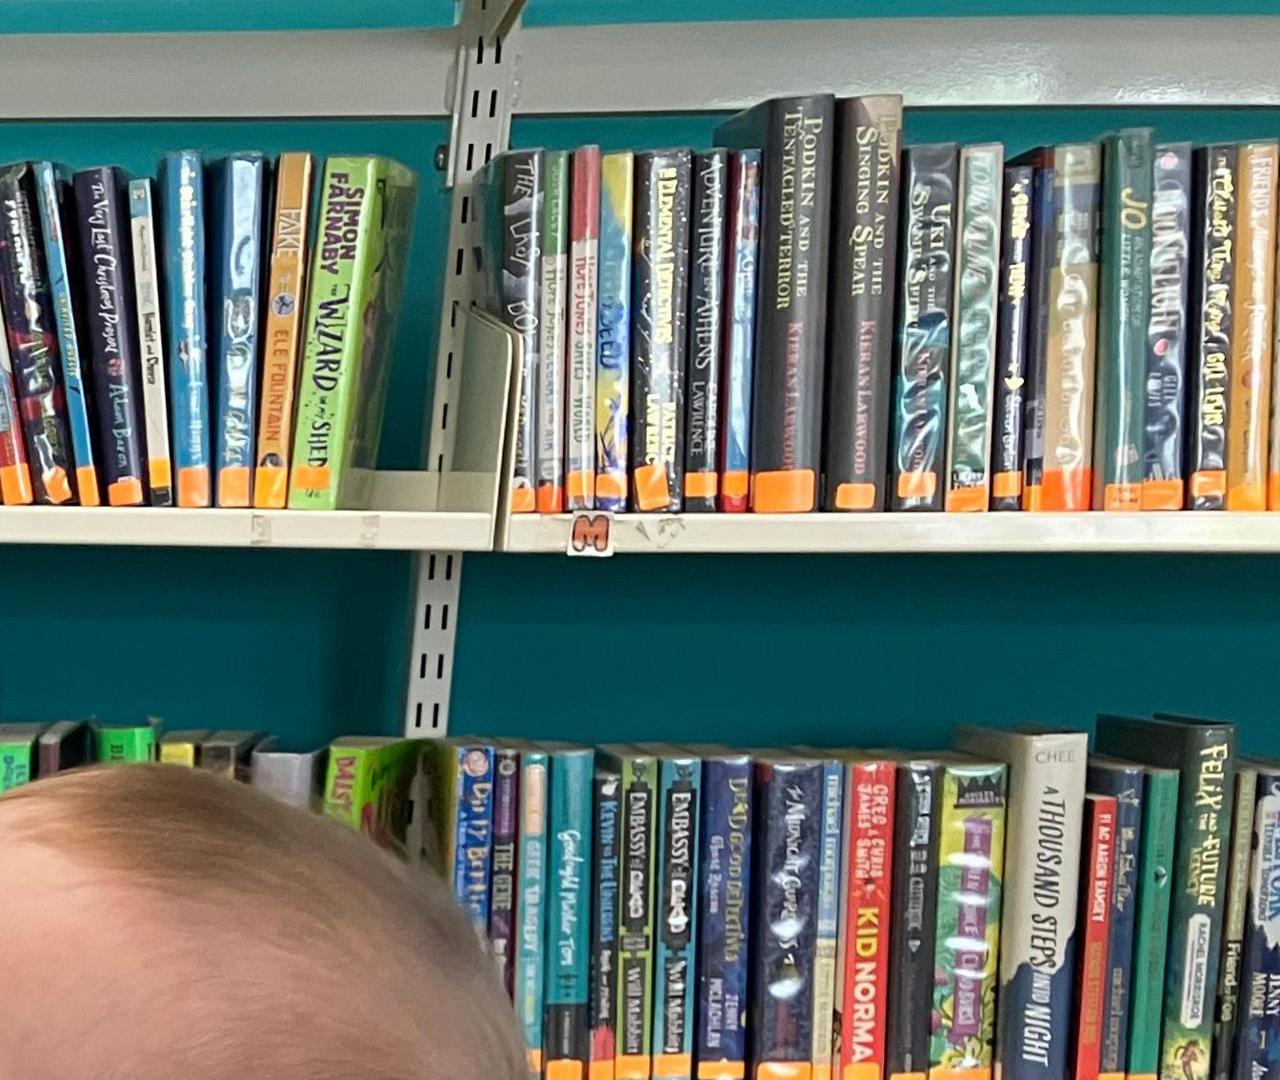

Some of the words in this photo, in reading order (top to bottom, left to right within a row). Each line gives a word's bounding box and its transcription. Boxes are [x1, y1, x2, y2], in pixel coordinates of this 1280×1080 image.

[511, 159, 535, 199] THE
[780, 109, 803, 229] TENTACLED
[800, 115, 824, 206] PODKIN
[854, 125, 877, 215] SINGING
[88, 200, 109, 225] Very
[319, 172, 349, 275] FARNABY
[339, 187, 365, 260] SIMON
[655, 179, 677, 259] ELEMENTAL
[697, 159, 723, 274] ADVENTURE
[872, 213, 887, 250] AND
[910, 186, 929, 259] SWAMP
[930, 201, 952, 250] UKI
[966, 160, 991, 286] TOURMALINE
[1119, 186, 1148, 230] JO
[91, 228, 112, 250] Last
[508, 217, 540, 271] LAST
[798, 215, 812, 251] AND
[1119, 232, 1131, 274] LITTLE
[93, 253, 118, 311] Christmas
[575, 255, 595, 291] HOPE
[775, 231, 795, 309] TERROR
[796, 260, 810, 298] THE
[848, 224, 875, 297] SPEAR
[870, 259, 885, 296] THE
[928, 257, 937, 283] AND
[142, 311, 156, 343] Hamlet
[654, 261, 676, 345] DETECTIVES
[98, 313, 119, 353] Present
[273, 330, 289, 357] ELE
[312, 284, 351, 392] WIZARD
[695, 295, 718, 369] ATHENS
[785, 321, 803, 386] KIERAN
[857, 319, 876, 386] KIERAN
[108, 383, 126, 424] Adam
[265, 363, 290, 442] FOUNTAIN
[689, 381, 706, 457] LAWRENCE
[112, 427, 132, 468] Baron
[853, 389, 874, 475] LARWOOD
[571, 514, 610, 552] M
[1035, 752, 1075, 762] CHEE
[1196, 743, 1229, 810] FELIX
[857, 783, 873, 829] JAMES
[872, 784, 889, 826] GREG
[1042, 786, 1060, 796] A
[600, 801, 616, 845] KEVIN
[628, 791, 646, 859] EMBASSY
[671, 791, 691, 868] EMBASSY
[601, 856, 616, 879] THE
[855, 838, 870, 879] SMITH
[871, 838, 885, 877] CHRIS
[1032, 799, 1066, 908] THOUSAND
[1197, 834, 1220, 908] FUTURE
[855, 906, 878, 958] KID
[1029, 913, 1058, 969] STEPS
[1196, 922, 1208, 960] RACHEL
[1031, 972, 1051, 1004] INTO
[1224, 942, 1239, 986] Friend
[1249, 971, 1267, 1018] MOORE
[1022, 1001, 1053, 1067] NIGHT
